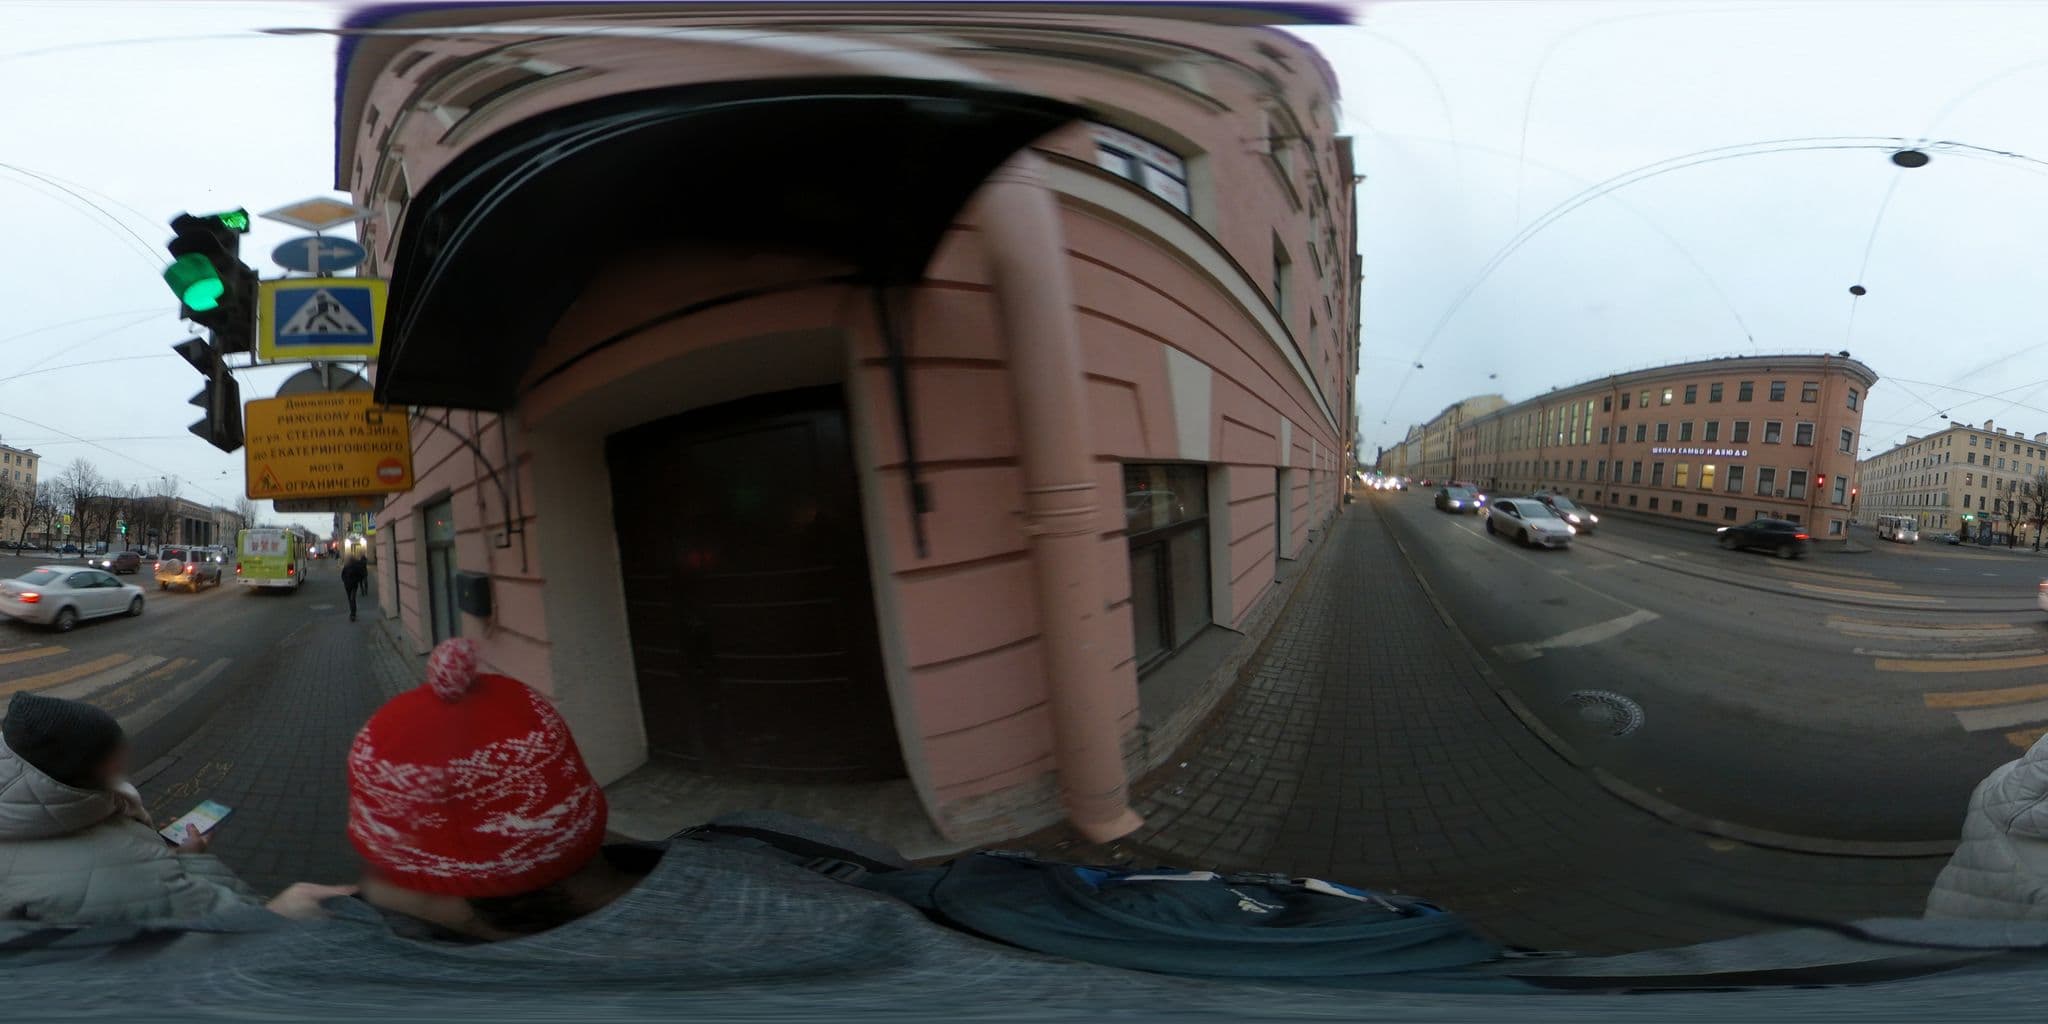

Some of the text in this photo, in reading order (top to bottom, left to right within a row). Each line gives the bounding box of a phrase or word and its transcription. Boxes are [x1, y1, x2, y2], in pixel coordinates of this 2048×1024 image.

[277, 411, 349, 424] РИЖСКОМУ
[286, 428, 345, 440] СТЕПАНА
[349, 425, 399, 437] РАЗИНА
[270, 442, 403, 459] ЕКАТЕРИНГОФСКОГО
[309, 463, 344, 473] моста
[285, 476, 370, 490] ОГРАНИЧЕНО
